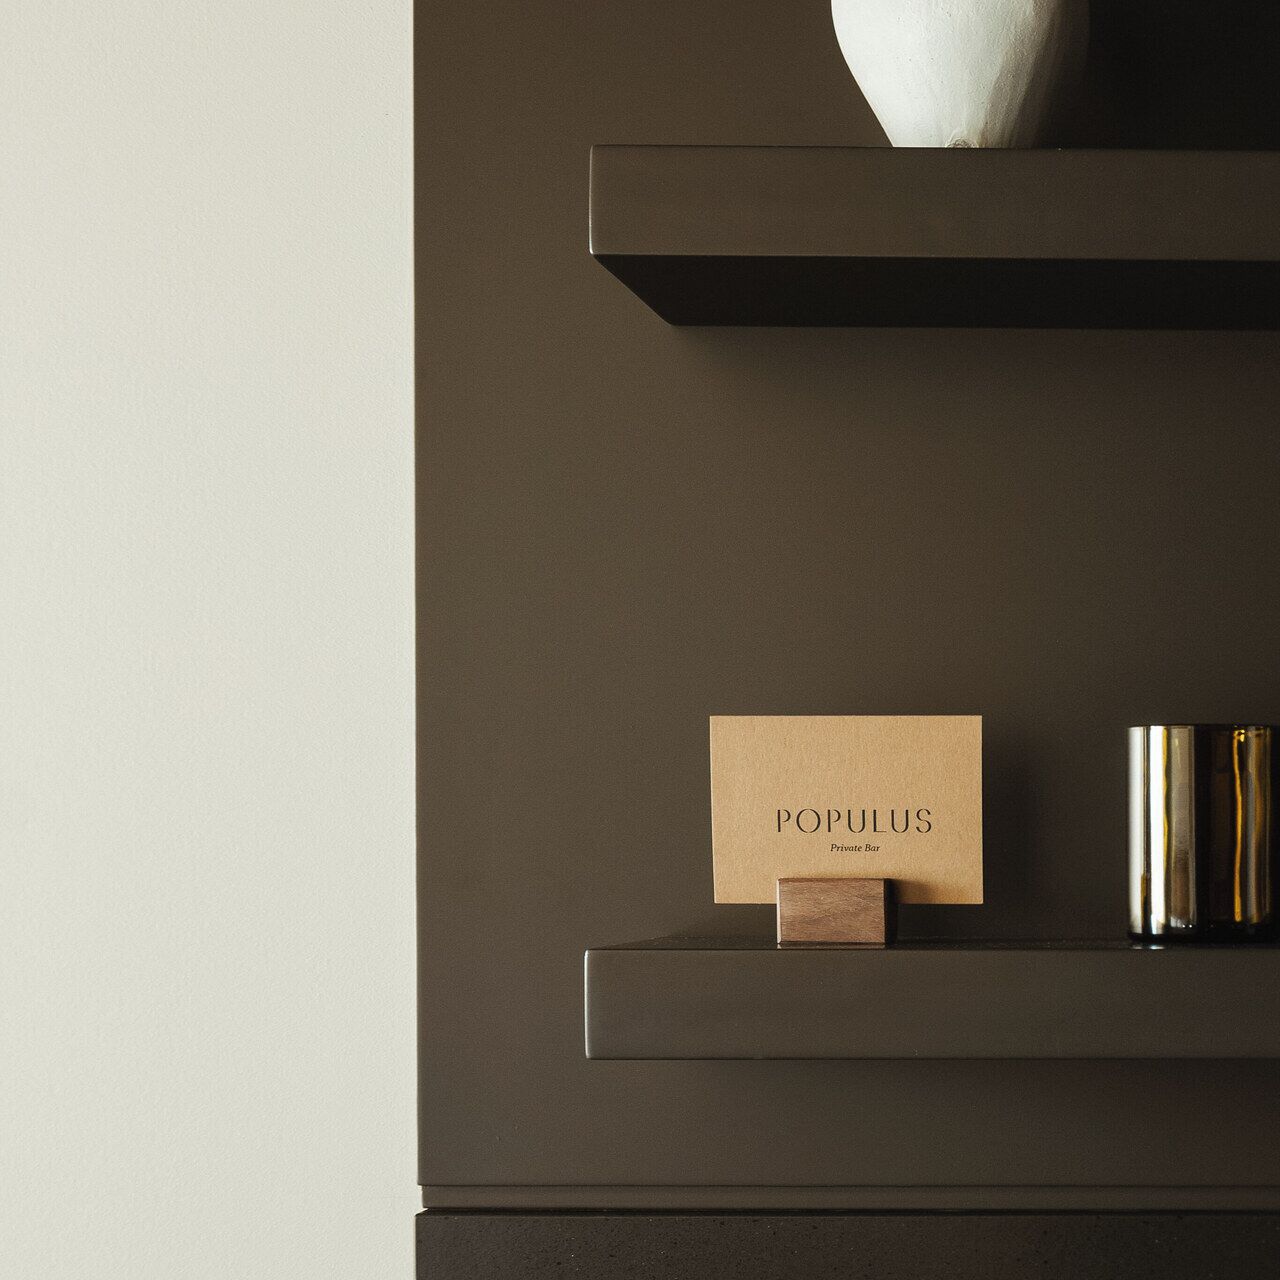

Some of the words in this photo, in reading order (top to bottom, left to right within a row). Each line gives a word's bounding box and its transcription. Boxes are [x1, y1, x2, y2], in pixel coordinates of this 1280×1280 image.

[777, 808, 932, 833] POPULUS
[830, 843, 862, 852] Private
[864, 844, 881, 852] Bar
